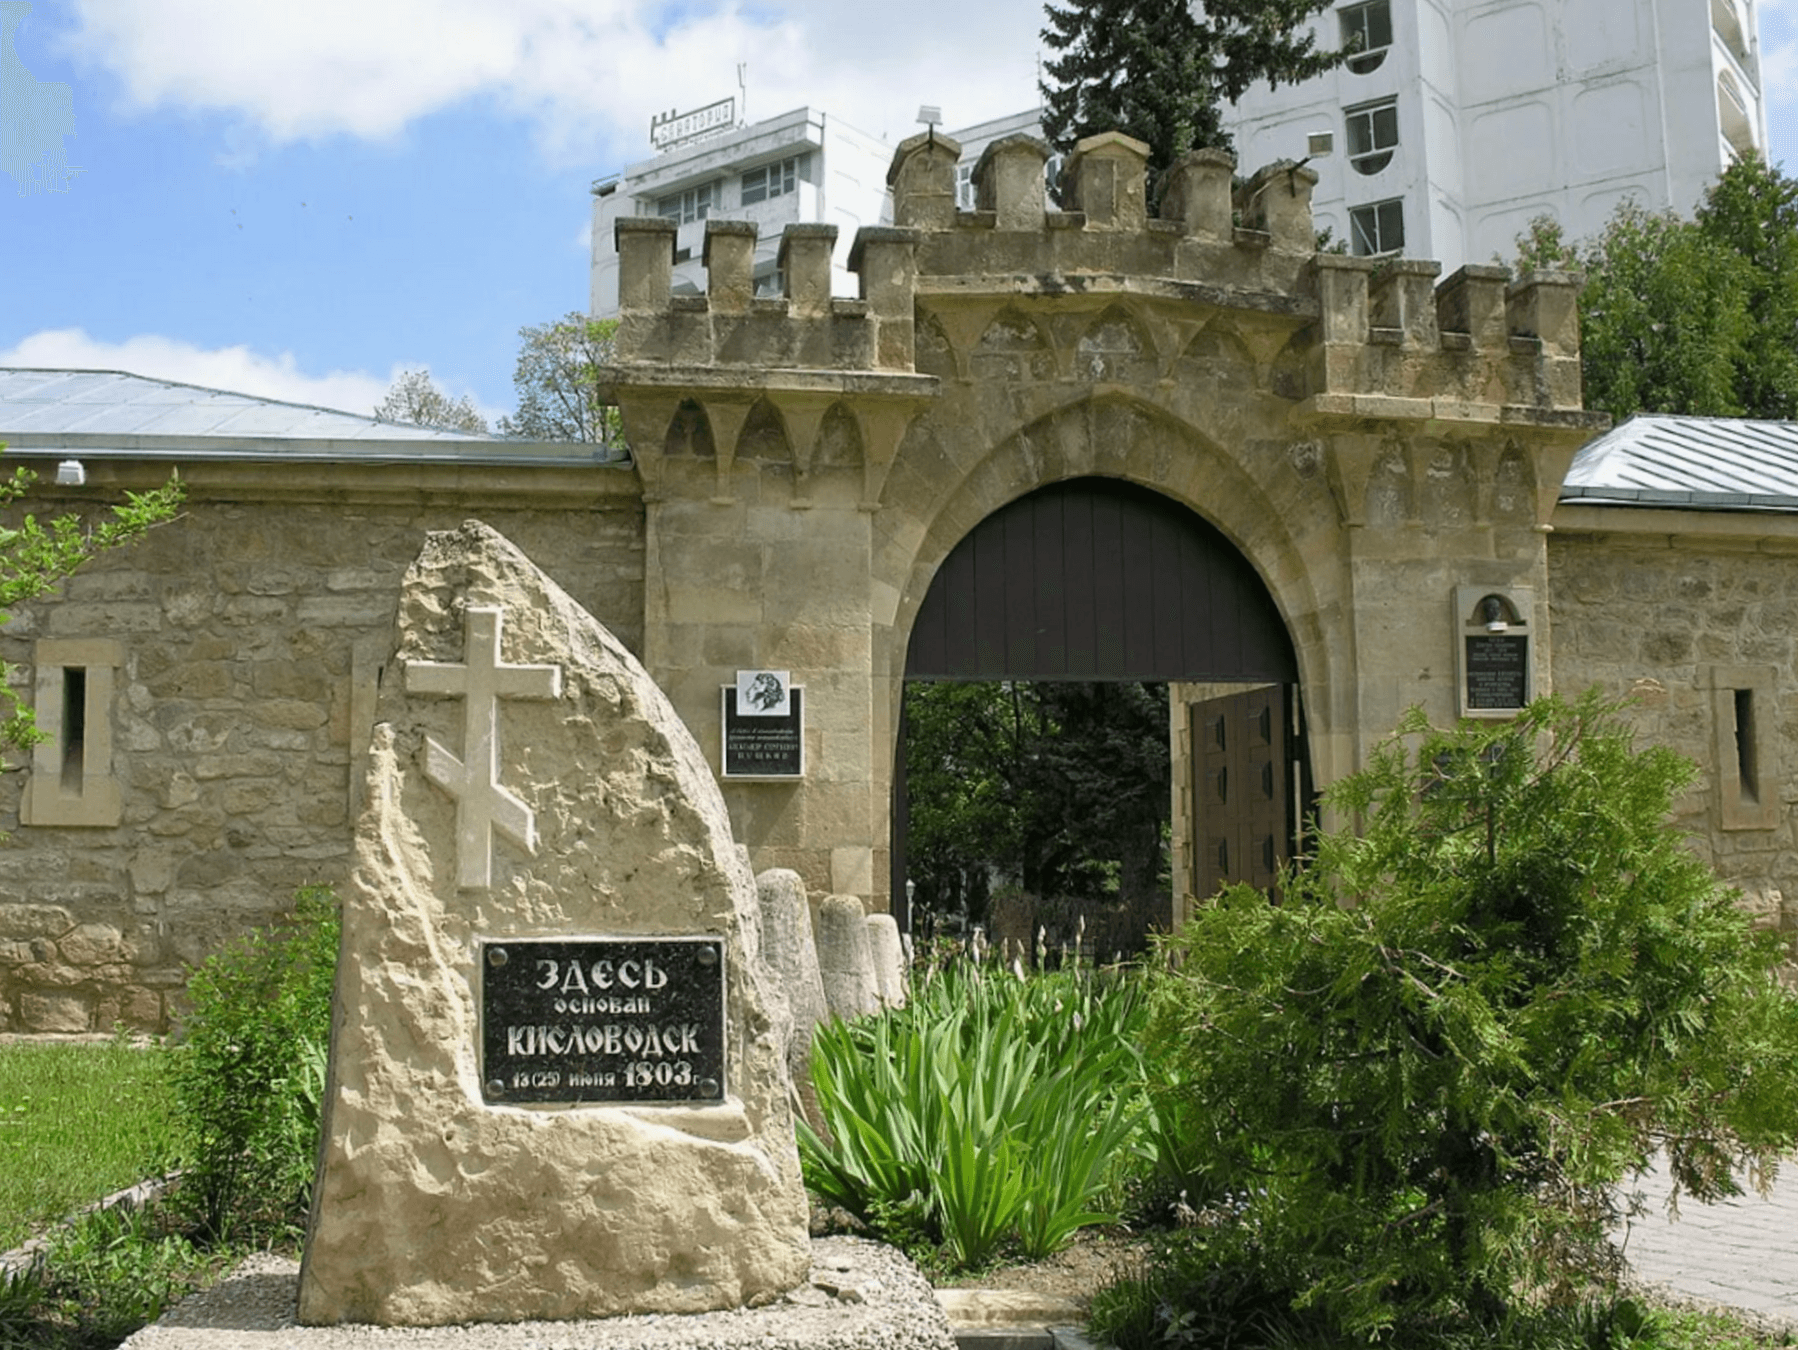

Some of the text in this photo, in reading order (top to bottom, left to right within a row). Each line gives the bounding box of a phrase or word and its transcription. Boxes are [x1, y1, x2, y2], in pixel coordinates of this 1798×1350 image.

[536, 959, 668, 995] ЗДЕСЬ
[554, 997, 651, 1014] основан
[507, 1023, 701, 1059] КИСЛОВОДСК
[512, 1071, 561, 1089] 13(25)
